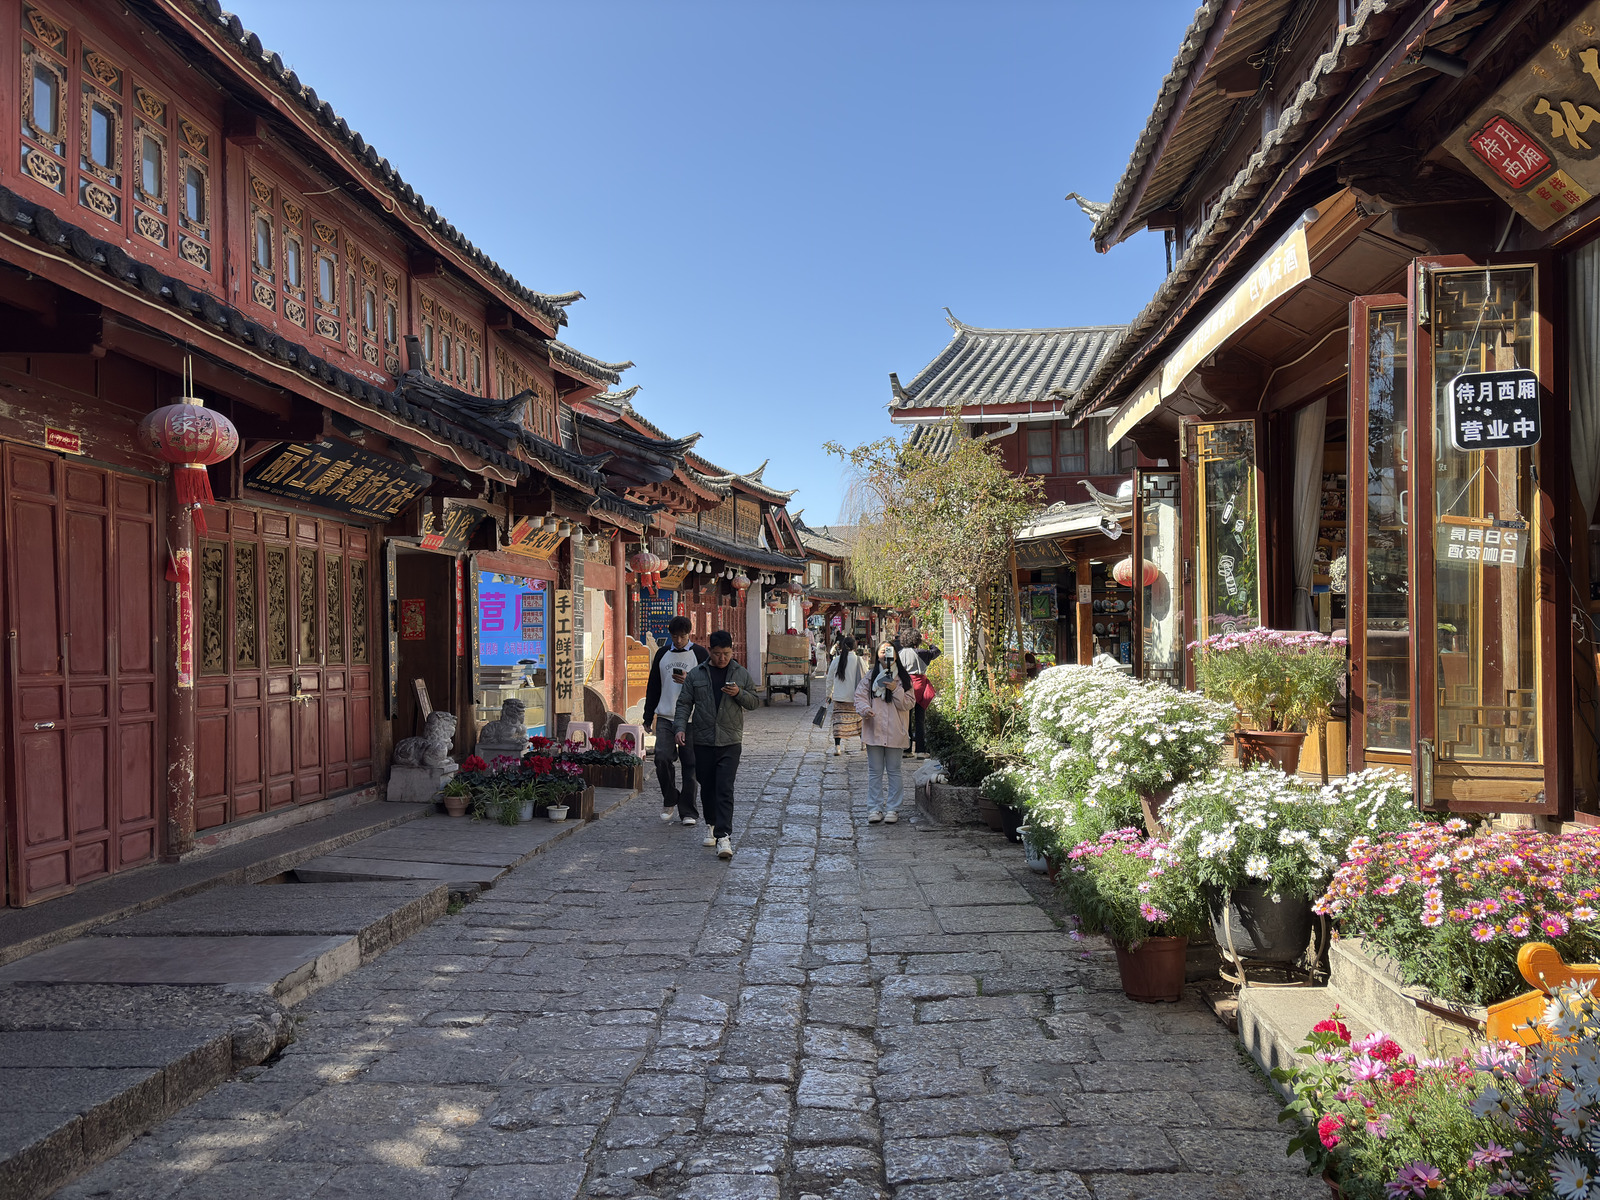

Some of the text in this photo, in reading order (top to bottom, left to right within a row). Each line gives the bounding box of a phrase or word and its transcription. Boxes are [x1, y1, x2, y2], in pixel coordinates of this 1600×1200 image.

[1478, 124, 1520, 161] 待月
[1501, 144, 1544, 180] 西厢
[1535, 176, 1567, 202] 客栈
[1550, 189, 1582, 214] 咖啡
[1456, 378, 1536, 405] 待月西厢
[1460, 417, 1536, 442] 营业中
[256, 443, 422, 515] 丽江康辉旅行社
[503, 641, 542, 655] 公司福利礼品
[555, 595, 573, 700] 手工鲜花饼
